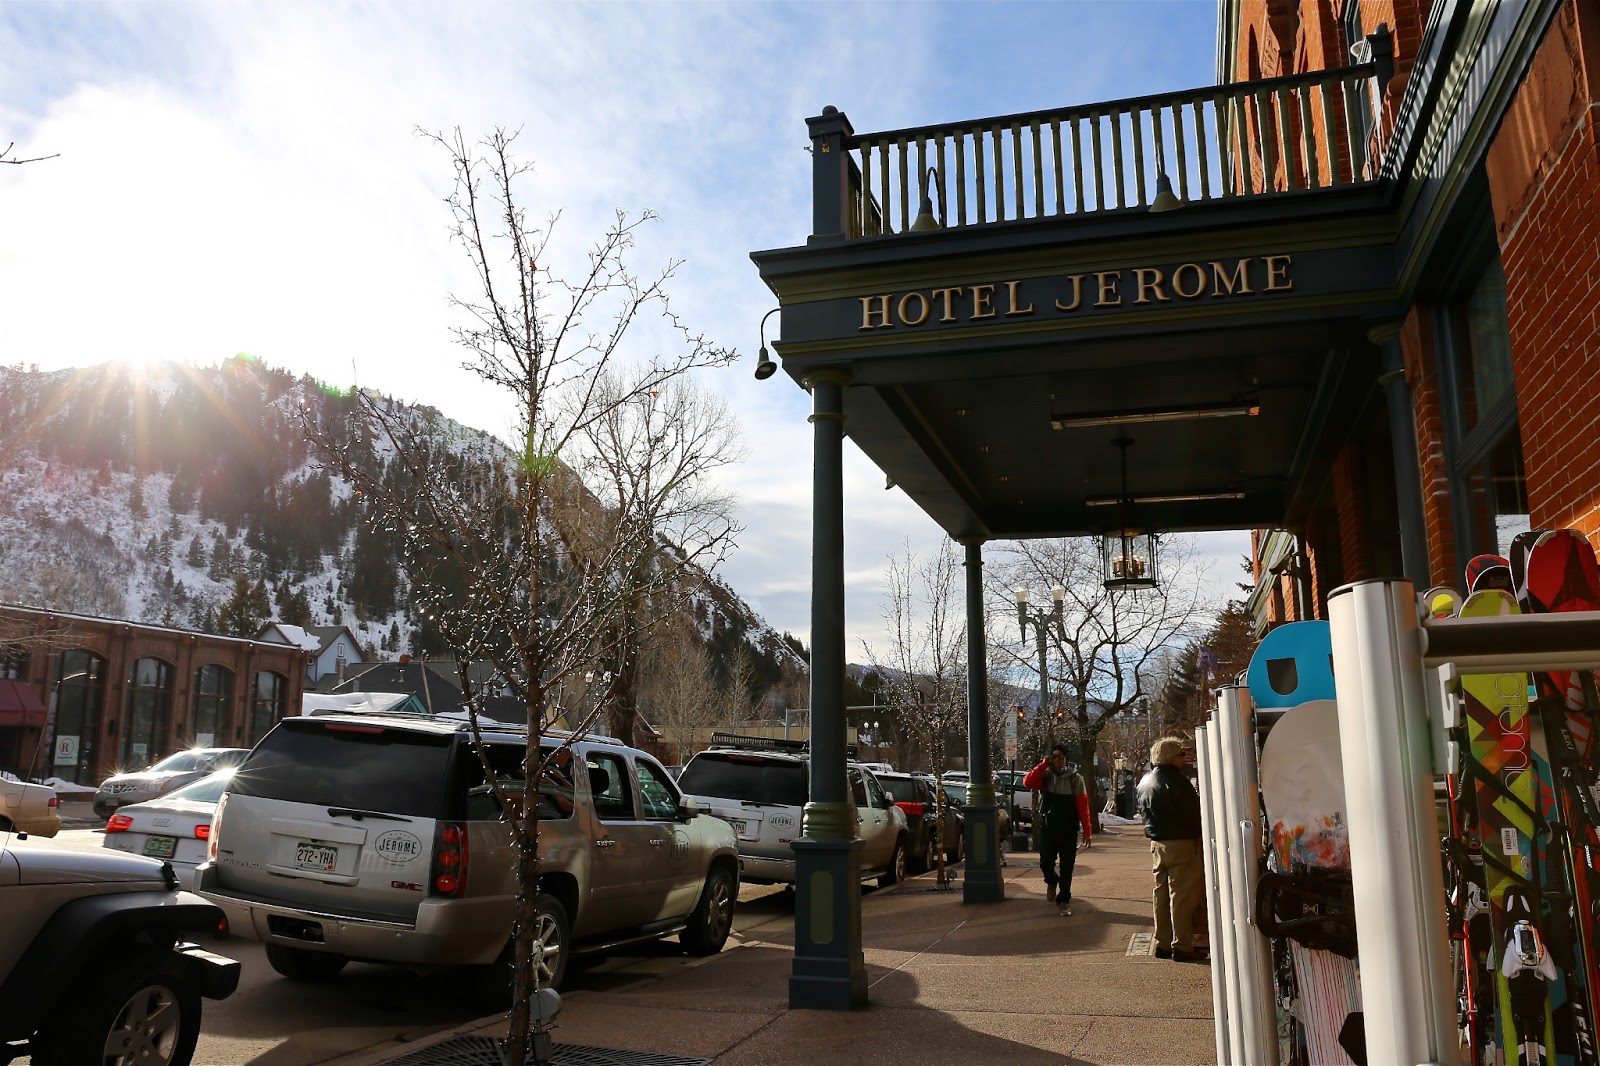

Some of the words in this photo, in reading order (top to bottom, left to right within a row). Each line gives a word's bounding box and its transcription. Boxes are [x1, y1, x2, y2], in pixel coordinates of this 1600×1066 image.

[858, 280, 1034, 332] HOTEL
[1055, 254, 1294, 311] JEROME
[1495, 672, 1531, 795] atomic
[1560, 728, 1575, 751] LEKI
[61, 743, 69, 752] R
[771, 817, 793, 826] JEROME
[379, 838, 418, 855] JEROME
[391, 880, 423, 892] GMC
